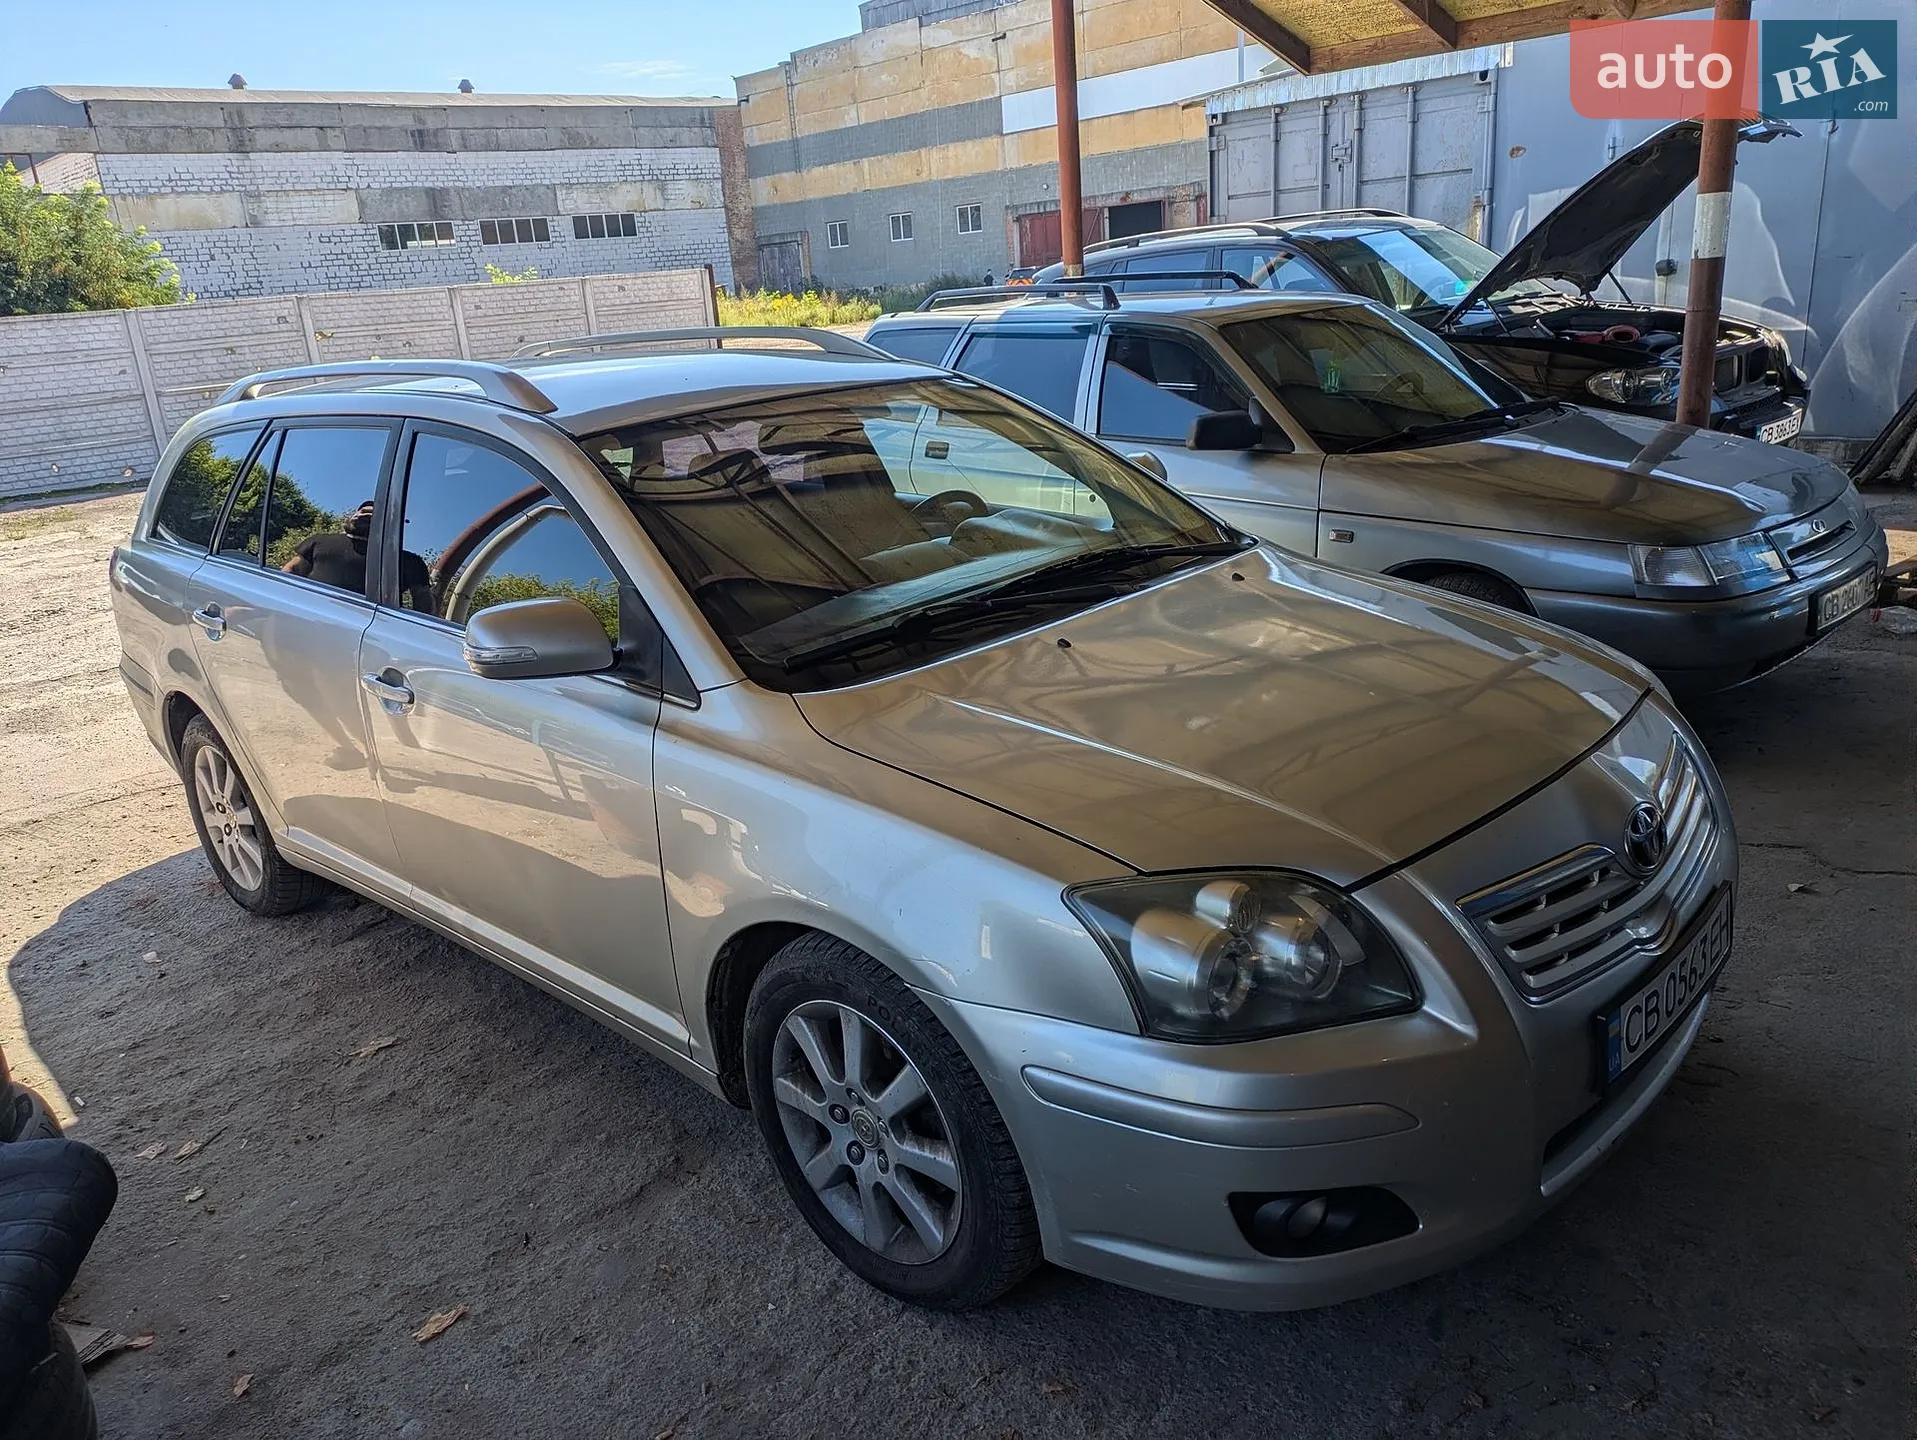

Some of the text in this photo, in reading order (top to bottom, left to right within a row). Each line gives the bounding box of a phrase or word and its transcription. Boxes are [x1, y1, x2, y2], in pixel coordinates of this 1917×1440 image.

[1824, 594, 1839, 621] CB
[1624, 899, 1730, 1054] CB 0563 EH
[1608, 1051, 1621, 1071] UA
